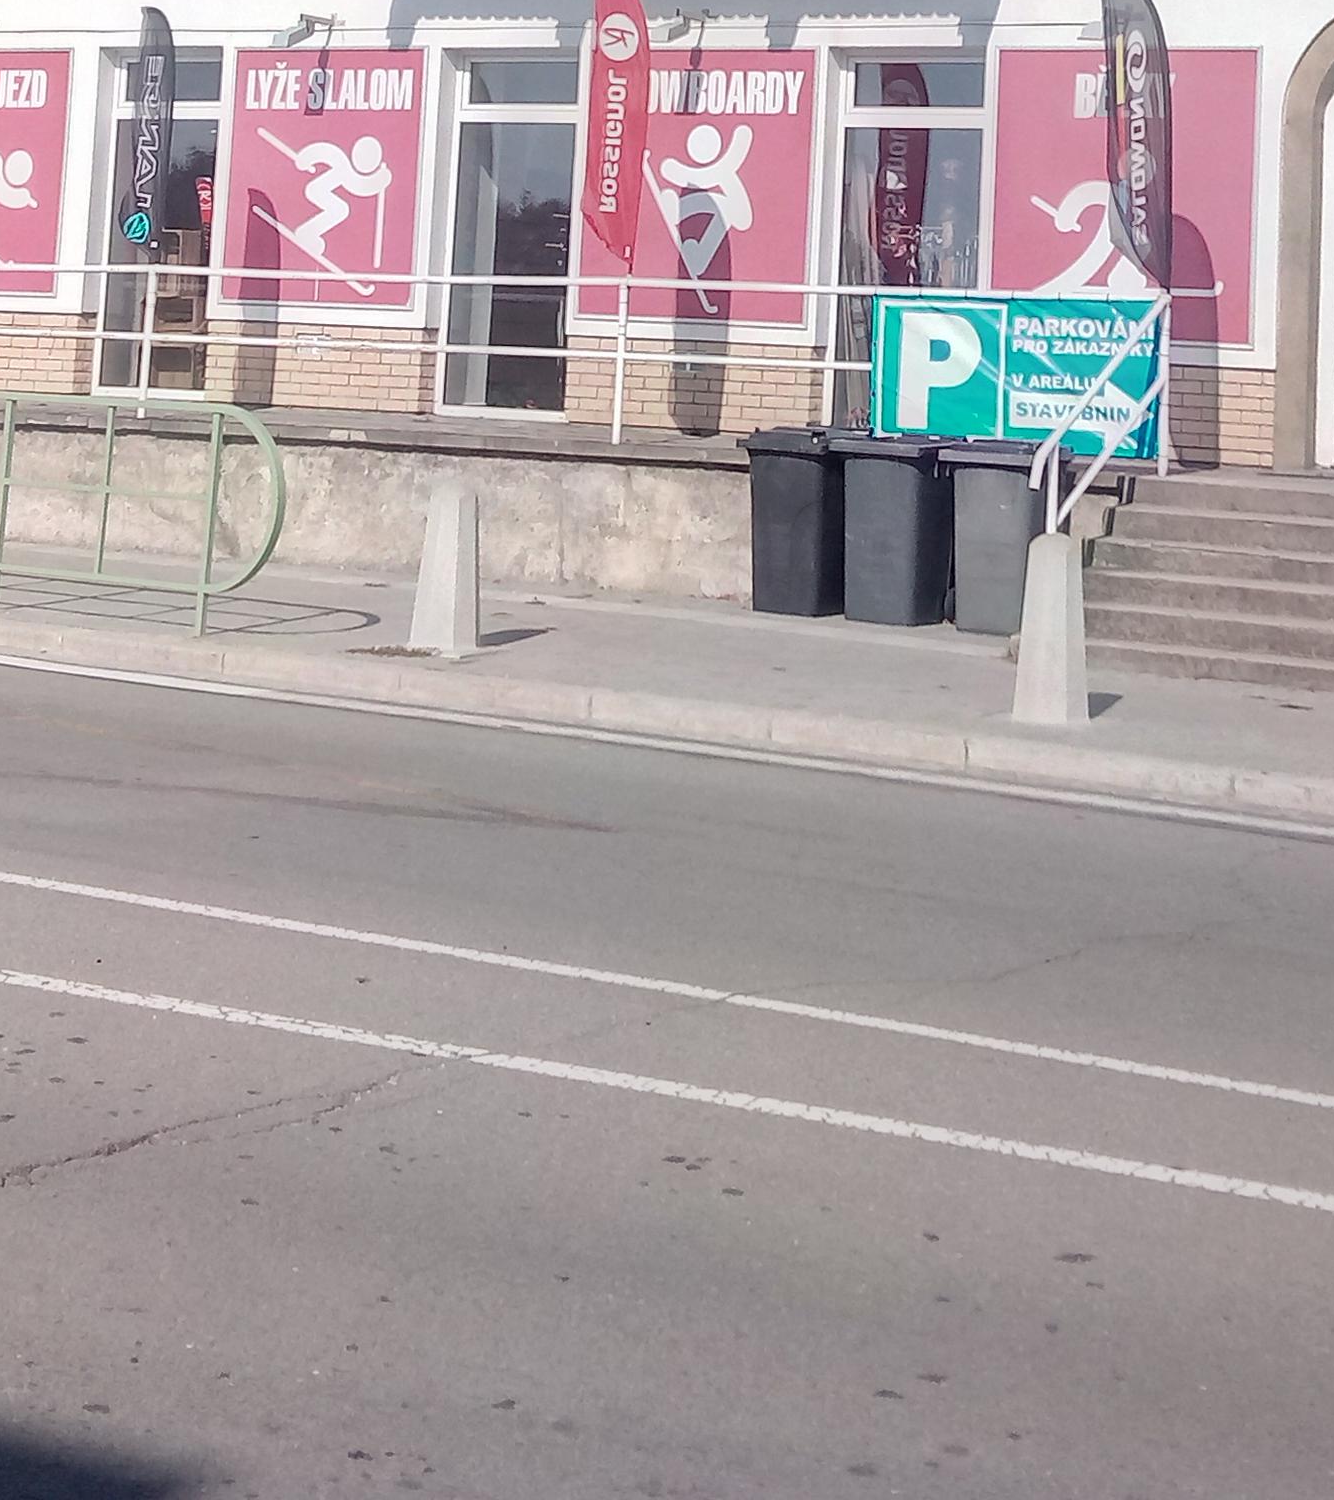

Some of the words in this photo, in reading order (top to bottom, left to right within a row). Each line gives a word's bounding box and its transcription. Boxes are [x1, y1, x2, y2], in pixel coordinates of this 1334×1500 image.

[245, 61, 302, 111] LYŽE
[307, 67, 415, 111] SLALOM
[646, 69, 806, 116] OWBOARDY
[896, 311, 983, 430] P
[1012, 339, 1048, 354] PRO
[1052, 338, 1154, 358] ZÁKAZNKY
[1011, 373, 1024, 388] V
